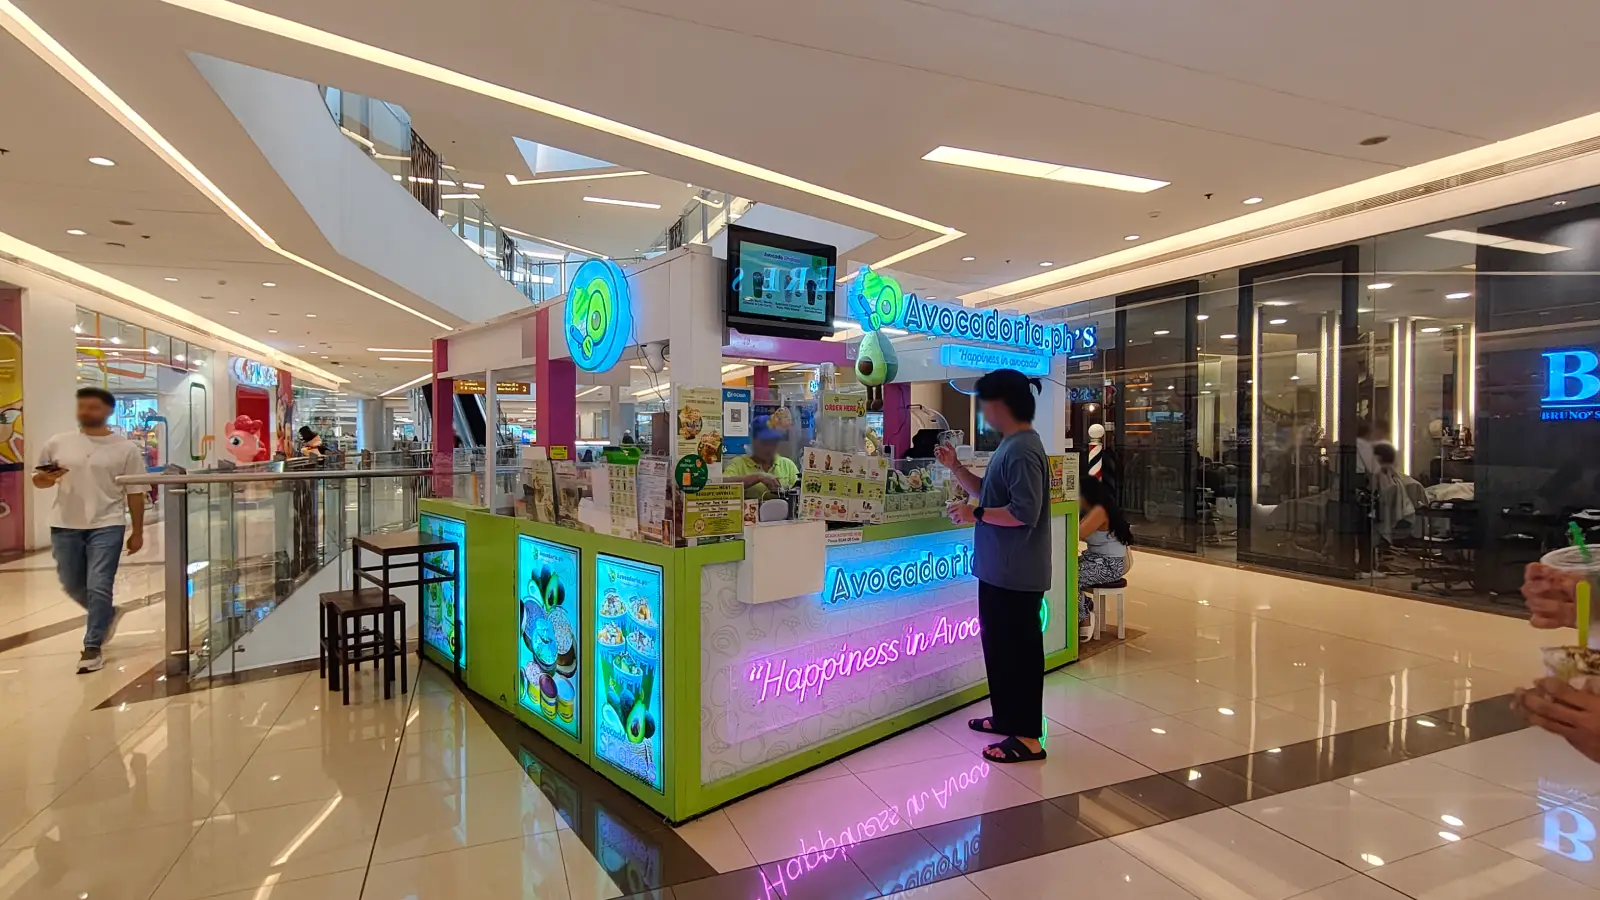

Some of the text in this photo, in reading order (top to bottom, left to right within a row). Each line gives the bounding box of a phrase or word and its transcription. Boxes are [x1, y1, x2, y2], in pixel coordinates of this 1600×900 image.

[1541, 350, 1600, 401] B
[824, 403, 857, 412] ORDER HERE
[905, 626, 929, 656] in
